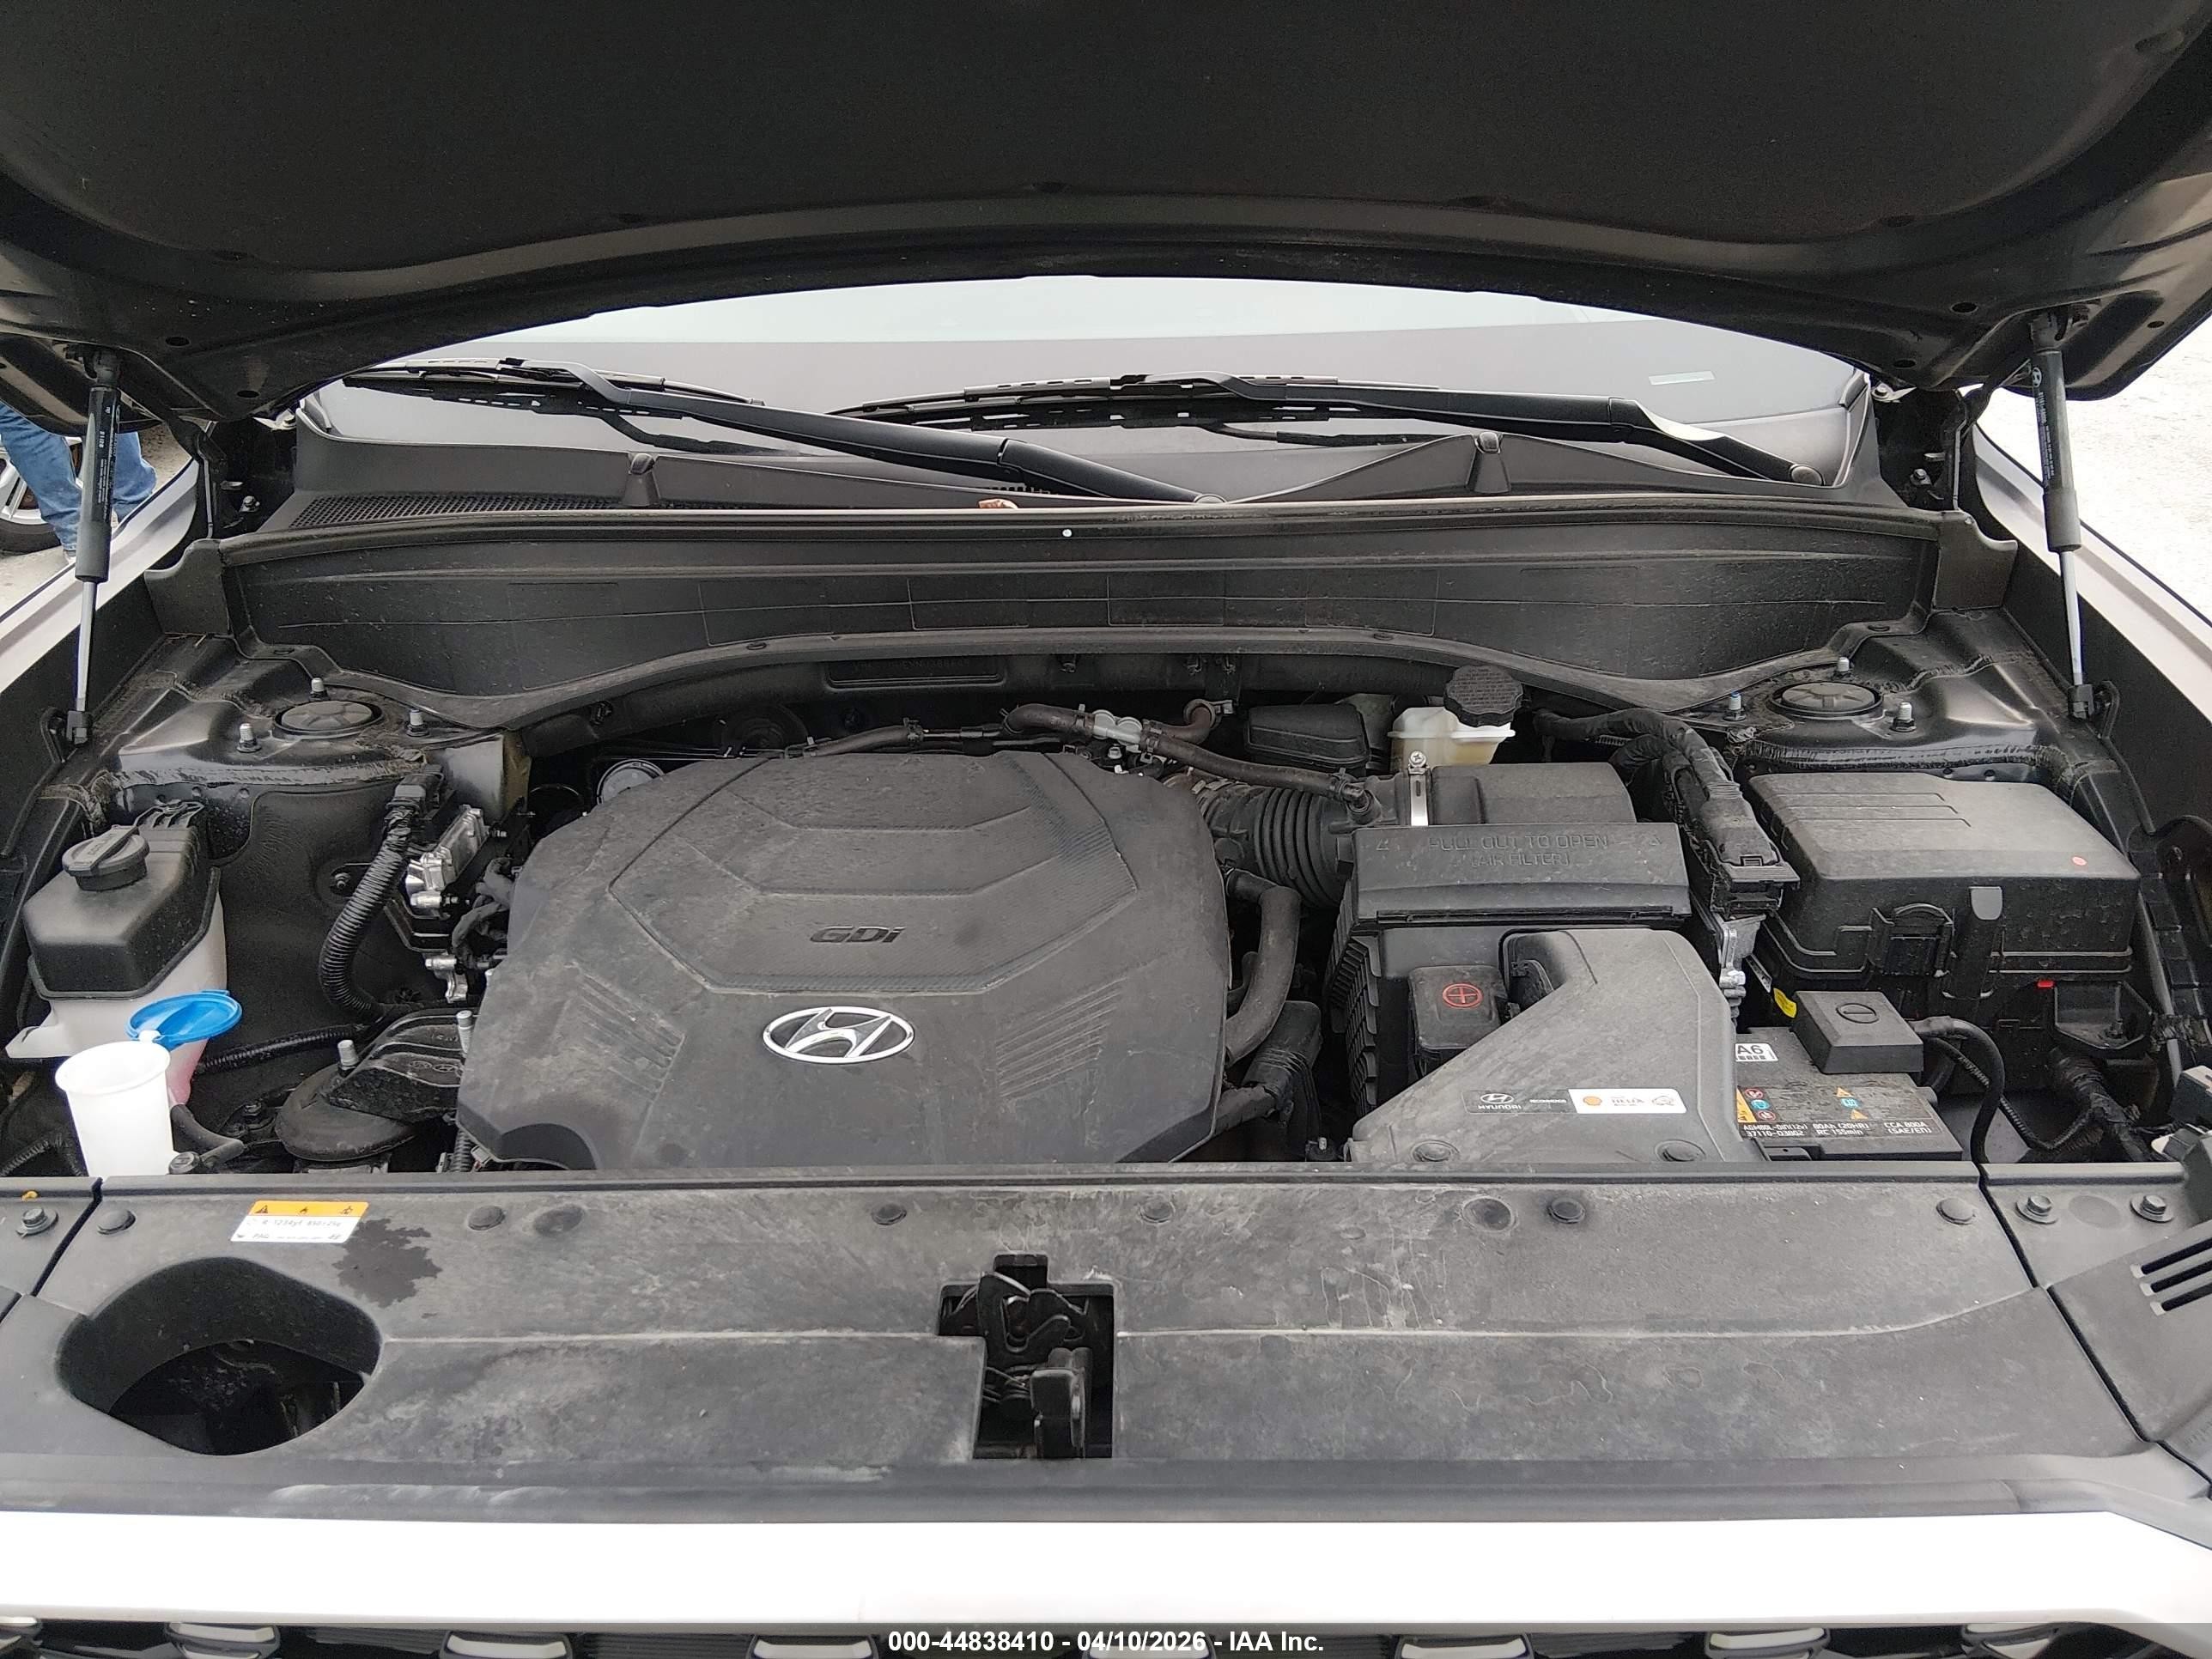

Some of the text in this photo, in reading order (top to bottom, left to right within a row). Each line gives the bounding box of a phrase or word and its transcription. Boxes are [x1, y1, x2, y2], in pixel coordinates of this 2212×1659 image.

[1428, 834, 1608, 851] PULL OUT TO OPEN
[810, 926, 906, 943] GDi
[1737, 1044, 1764, 1054] A6
